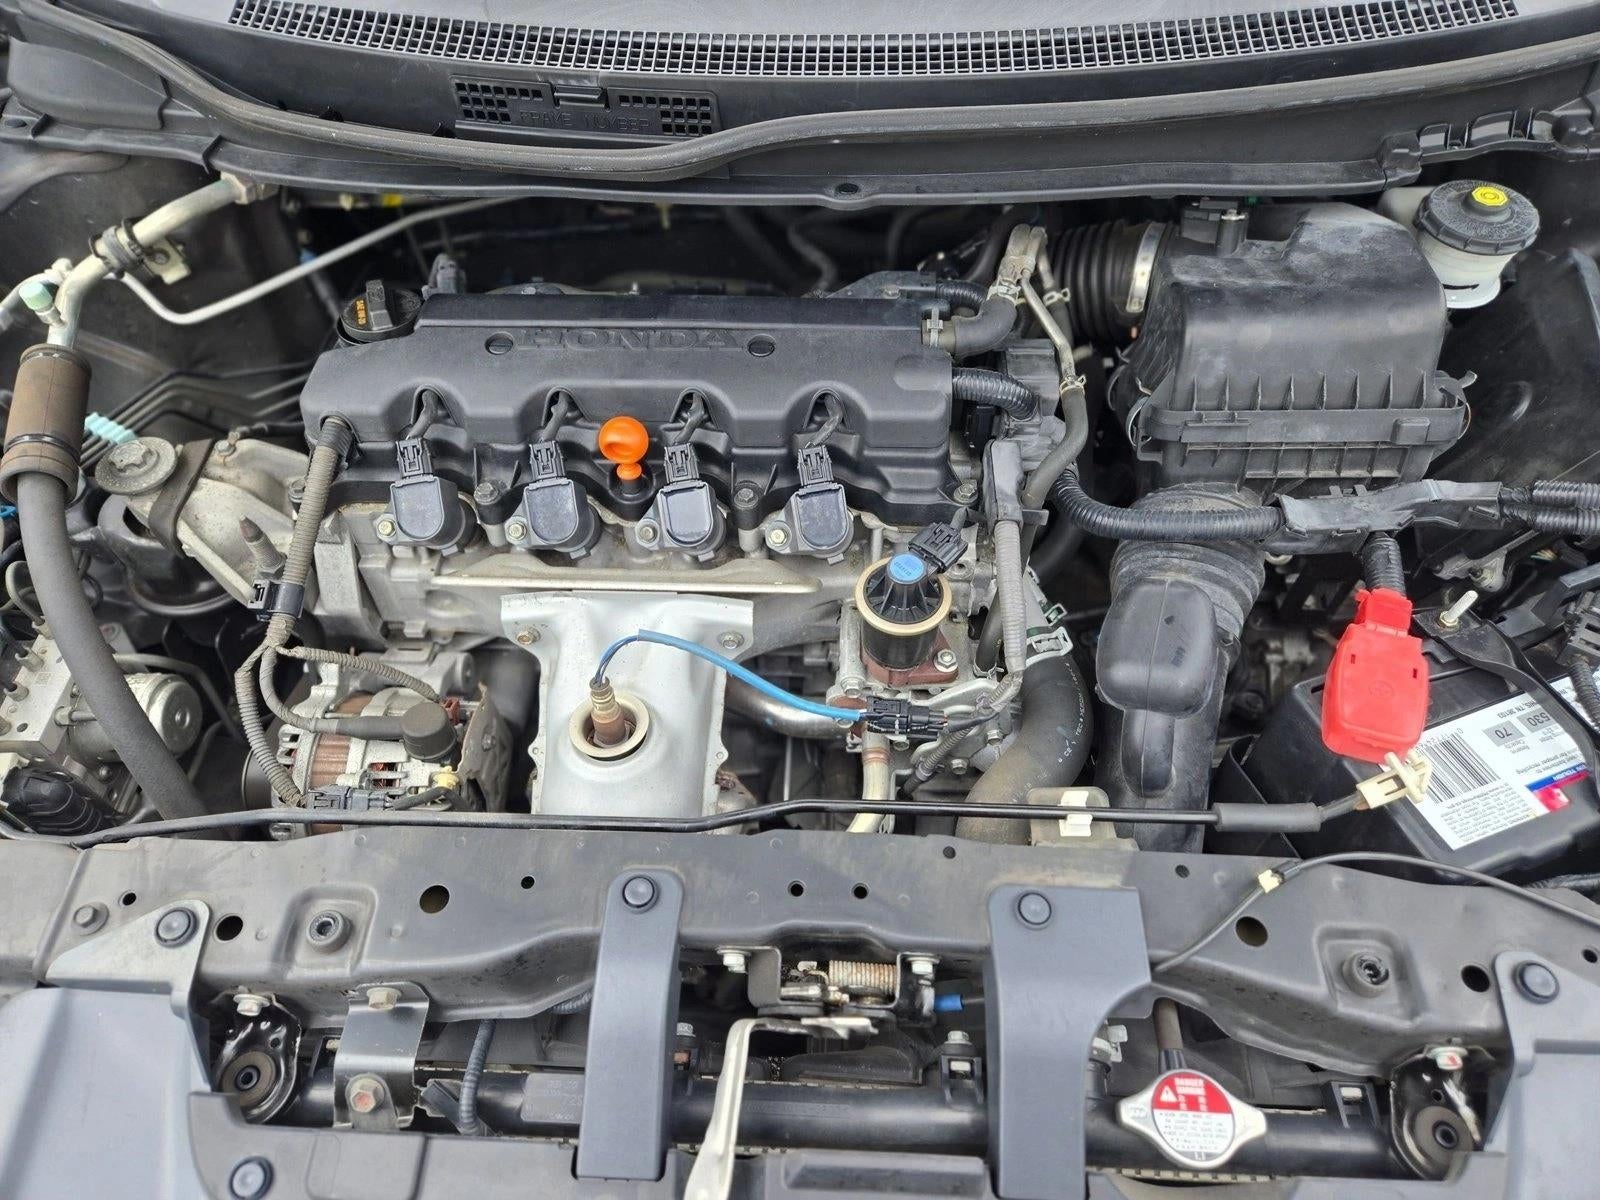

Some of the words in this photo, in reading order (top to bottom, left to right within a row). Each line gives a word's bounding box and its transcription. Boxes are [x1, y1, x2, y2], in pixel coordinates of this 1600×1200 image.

[520, 109, 573, 127] FRAME
[516, 327, 743, 350] HONDA
[1526, 712, 1550, 727] 530
[1494, 727, 1512, 739] 70
